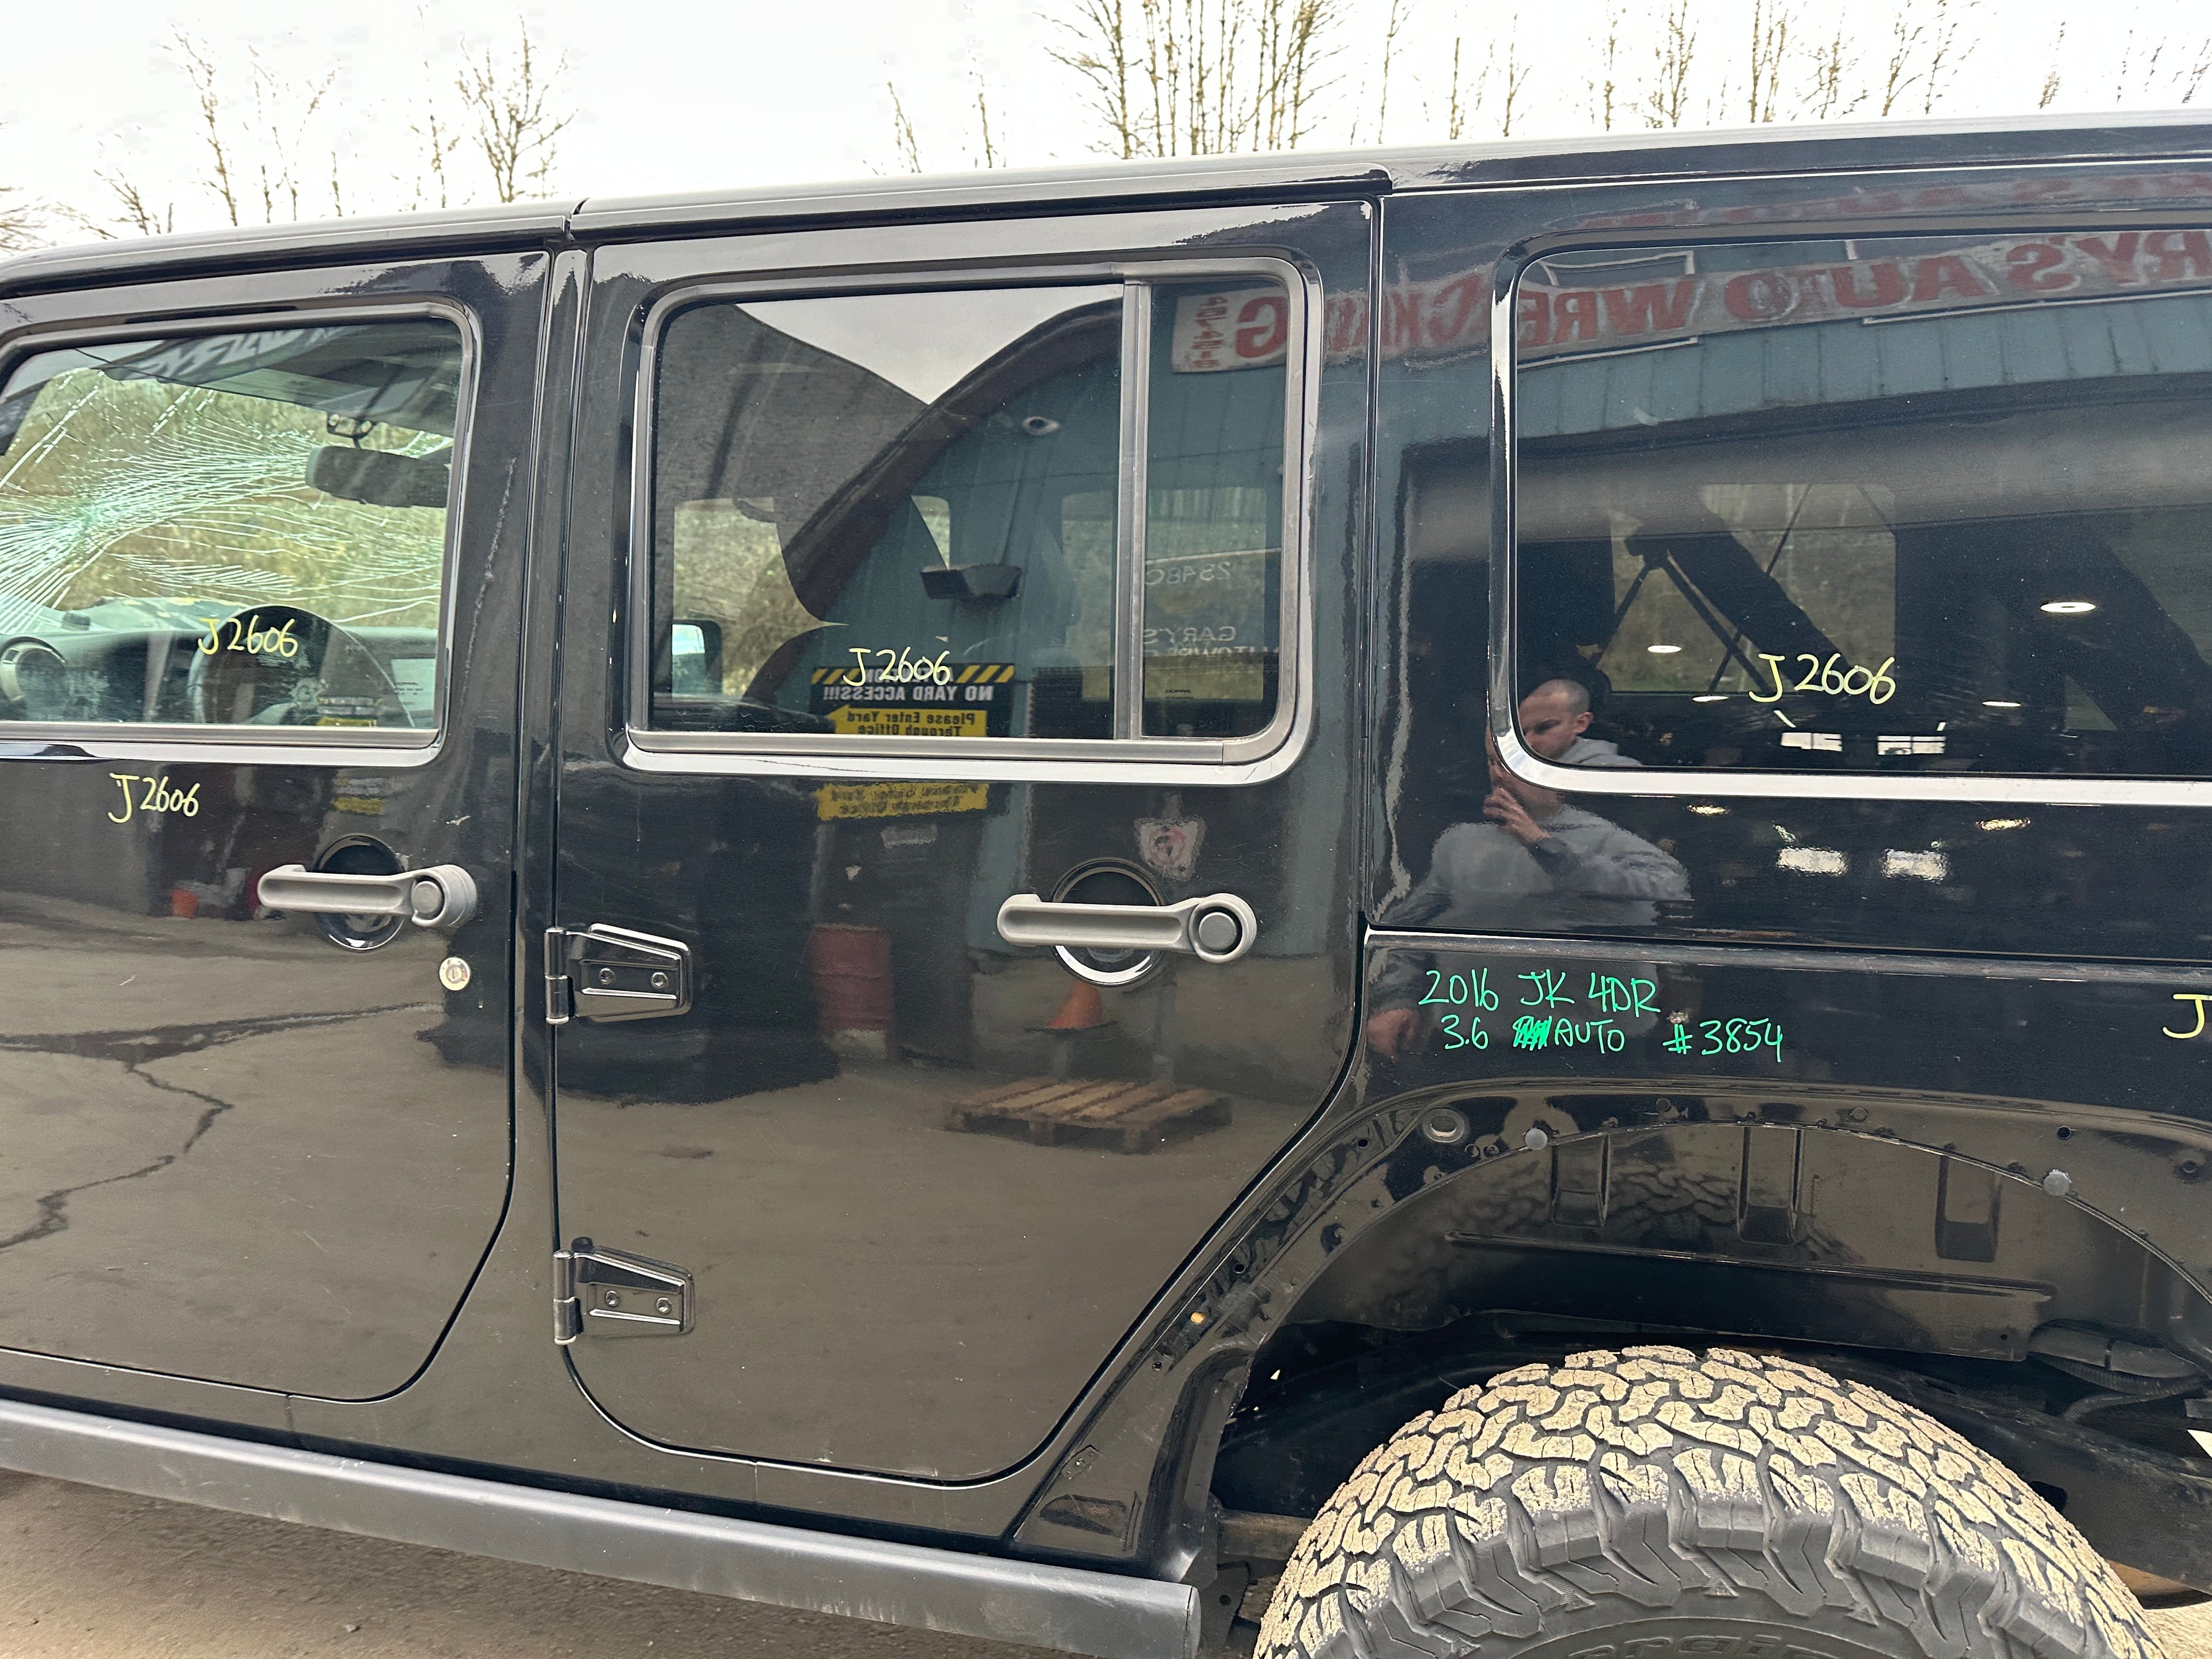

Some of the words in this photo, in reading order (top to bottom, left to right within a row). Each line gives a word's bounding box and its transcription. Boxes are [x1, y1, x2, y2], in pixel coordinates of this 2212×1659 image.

[198, 615, 298, 657] J2606
[843, 646, 951, 686] J2606
[1748, 653, 1896, 704] J2606
[108, 772, 201, 824] J2606
[1418, 968, 1499, 1012] 2016
[1518, 969, 1575, 1008] JK
[1587, 972, 1661, 1017] 4DR
[1440, 1014, 1489, 1051] 3.6
[1554, 1017, 1626, 1055] AUTO
[1663, 1017, 1783, 1063] #3854
